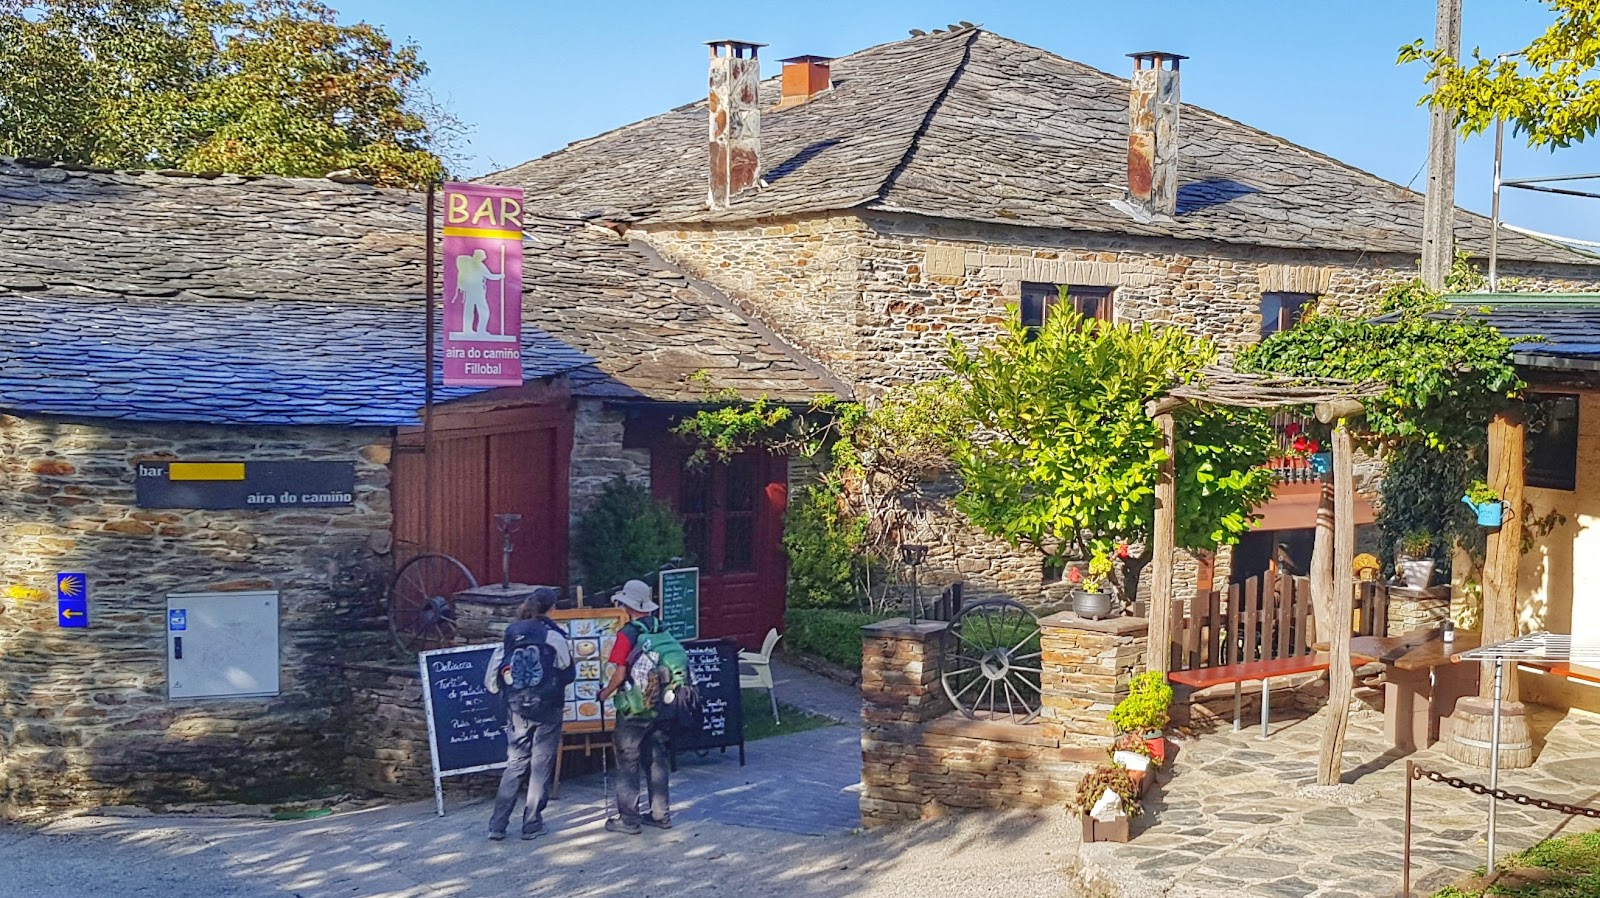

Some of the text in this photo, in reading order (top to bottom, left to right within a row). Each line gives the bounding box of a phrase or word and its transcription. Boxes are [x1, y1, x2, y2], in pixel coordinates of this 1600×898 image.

[448, 193, 522, 227] BAR
[446, 346, 520, 359] aira do camiño
[464, 362, 502, 375] Fillobal
[247, 490, 352, 504] aira do camiño
